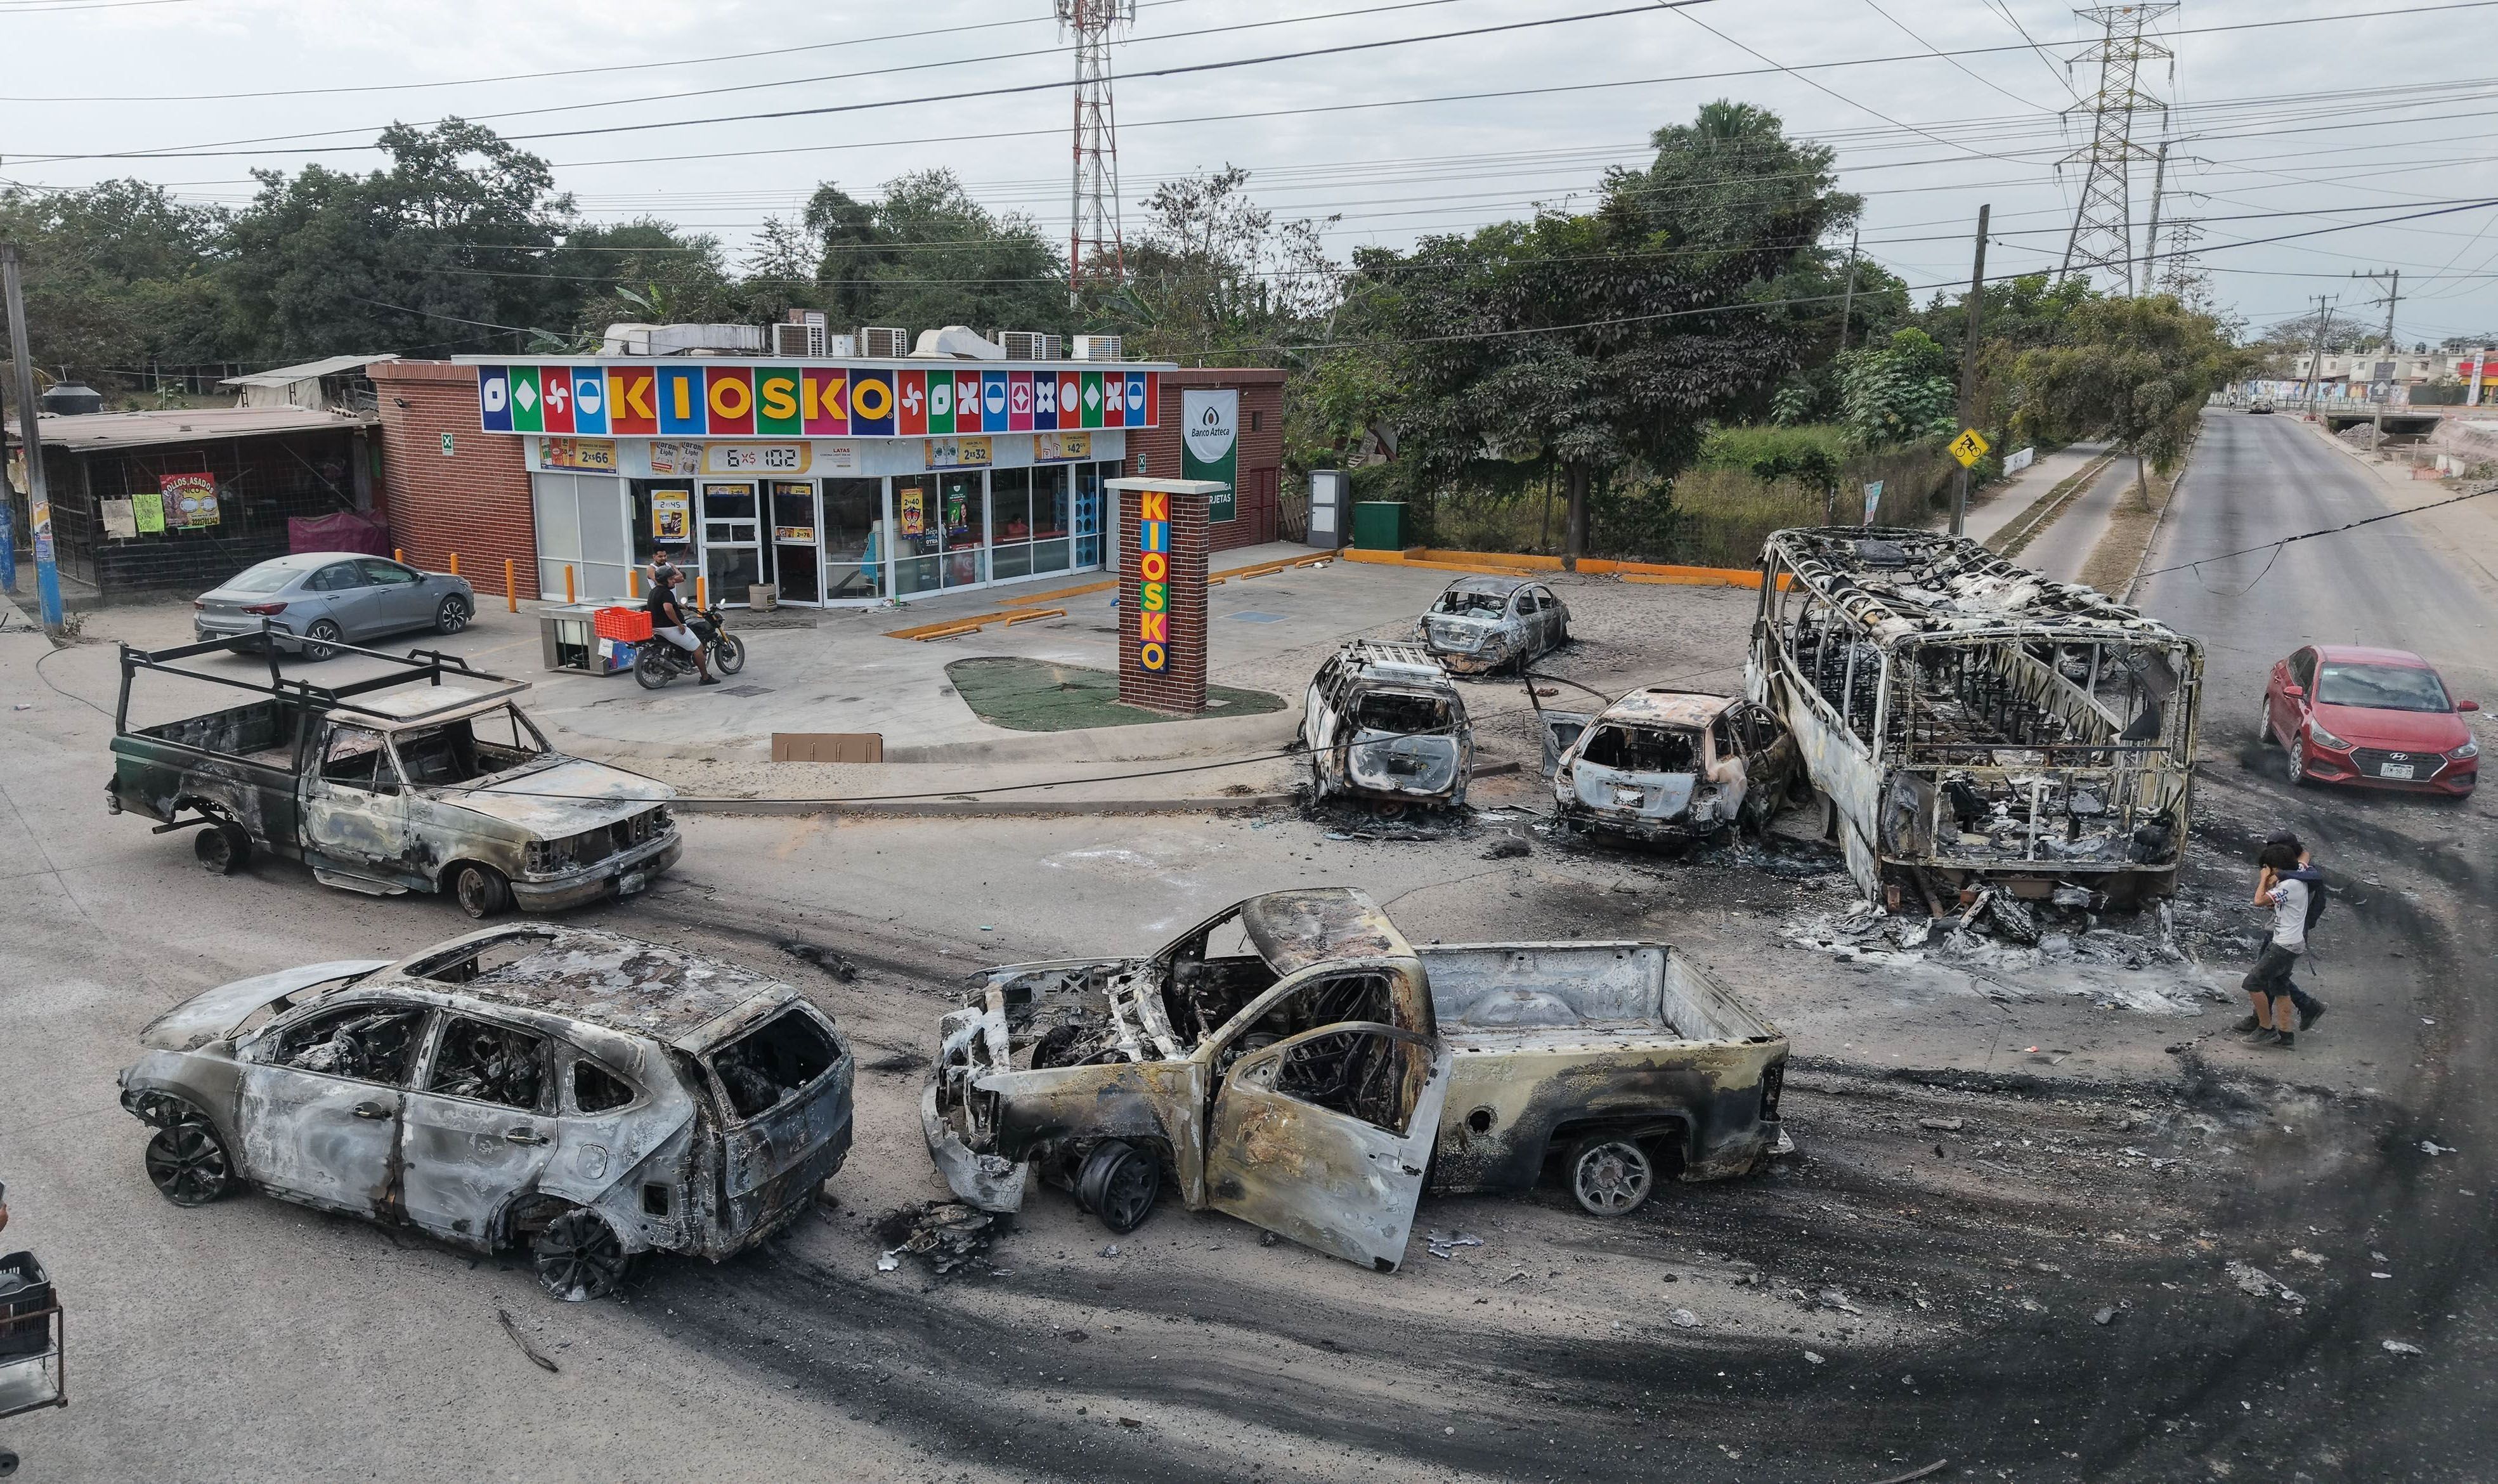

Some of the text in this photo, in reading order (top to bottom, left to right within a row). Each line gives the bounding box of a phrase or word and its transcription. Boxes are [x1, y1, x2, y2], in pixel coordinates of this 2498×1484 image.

[609, 376, 893, 420] KIOSKO
[1192, 427, 1230, 437] Banco Azteca
[660, 448, 673, 456] Light
[686, 448, 698, 456] Light
[765, 449, 796, 467] 102
[163, 477, 187, 497] POLLOS
[190, 476, 214, 494] ASADOS
[1209, 493, 1231, 505] RJETAS
[1141, 491, 1166, 670] KIOSKO
